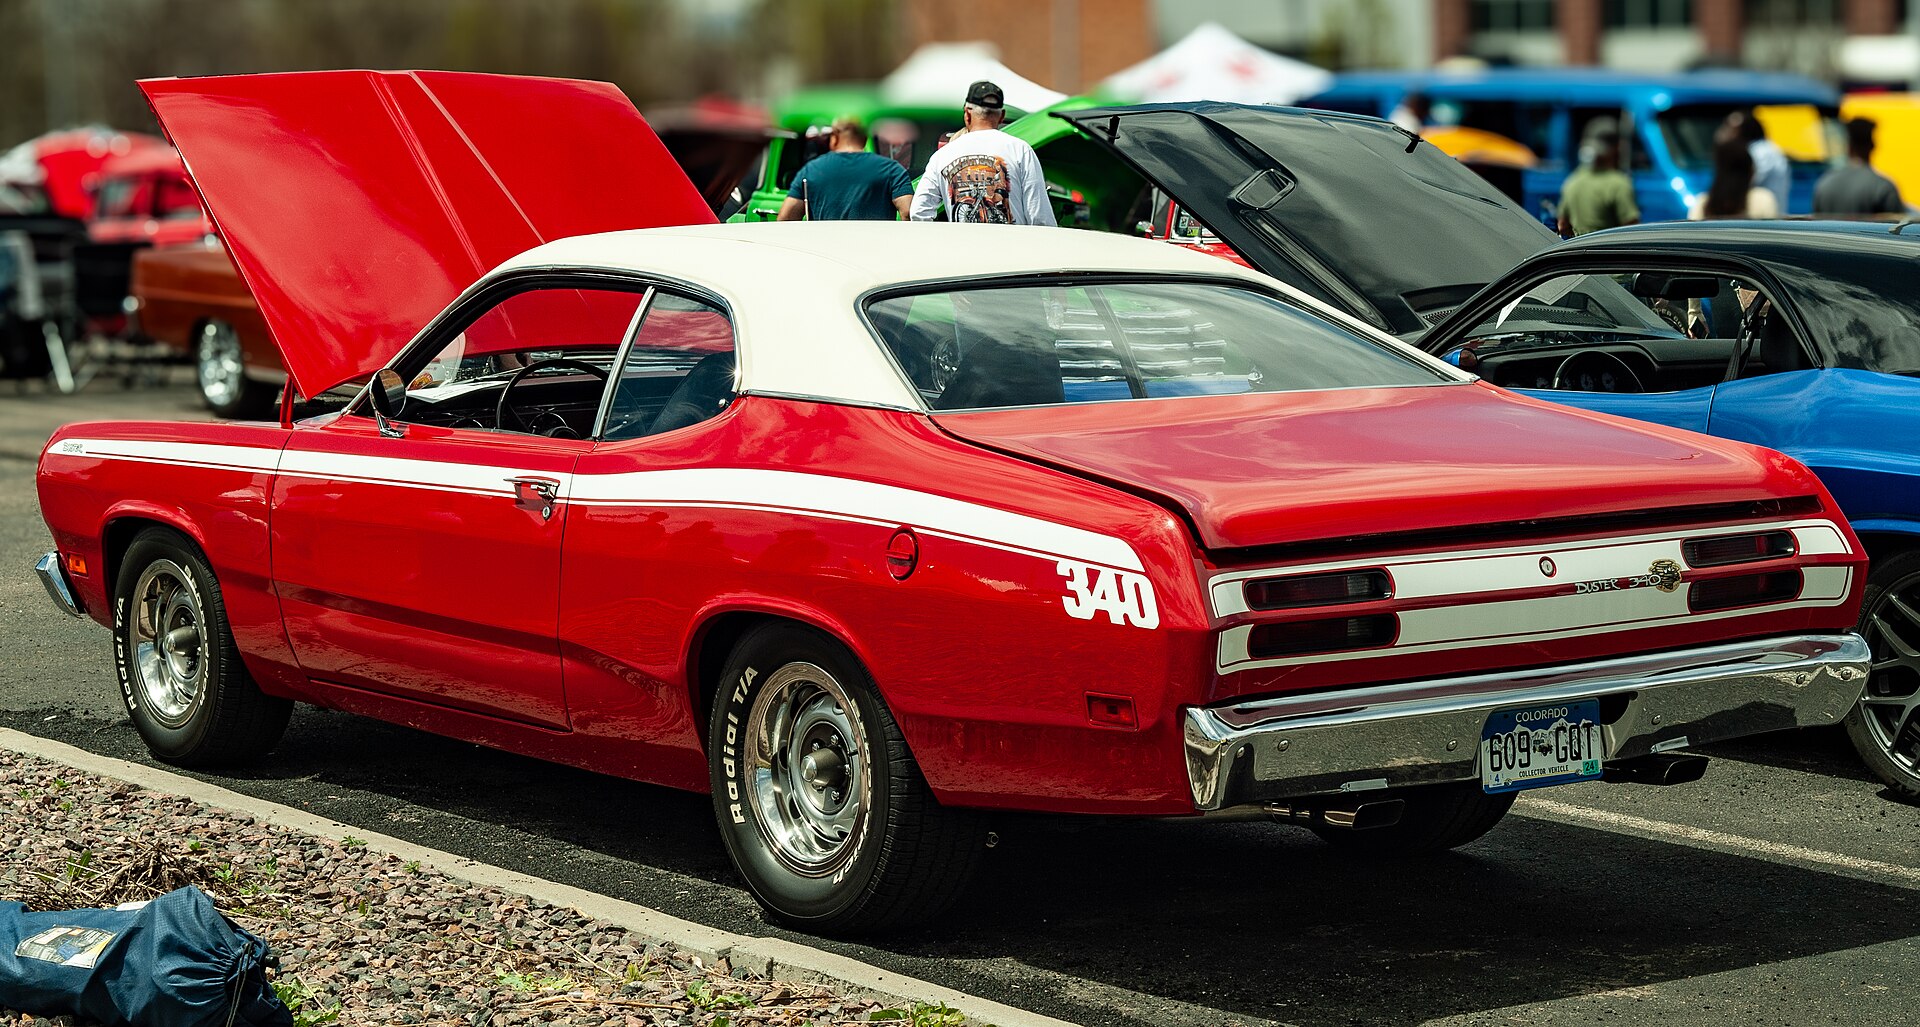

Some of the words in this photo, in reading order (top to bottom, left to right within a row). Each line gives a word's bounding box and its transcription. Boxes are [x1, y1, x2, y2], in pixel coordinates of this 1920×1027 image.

[1056, 560, 1160, 630] 340
[1575, 578, 1621, 594] DUSTER
[1628, 573, 1662, 588] 340
[115, 597, 125, 630] T/A
[732, 666, 759, 706] T/A
[1515, 706, 1568, 723] COLORADO
[1490, 730, 1531, 772] 609
[1555, 722, 1595, 763] GQT
[722, 712, 747, 825] Radial
[1518, 767, 1546, 778] COLLECTOR
[1548, 764, 1569, 774] VEHICLE
[1585, 761, 1596, 772] 24
